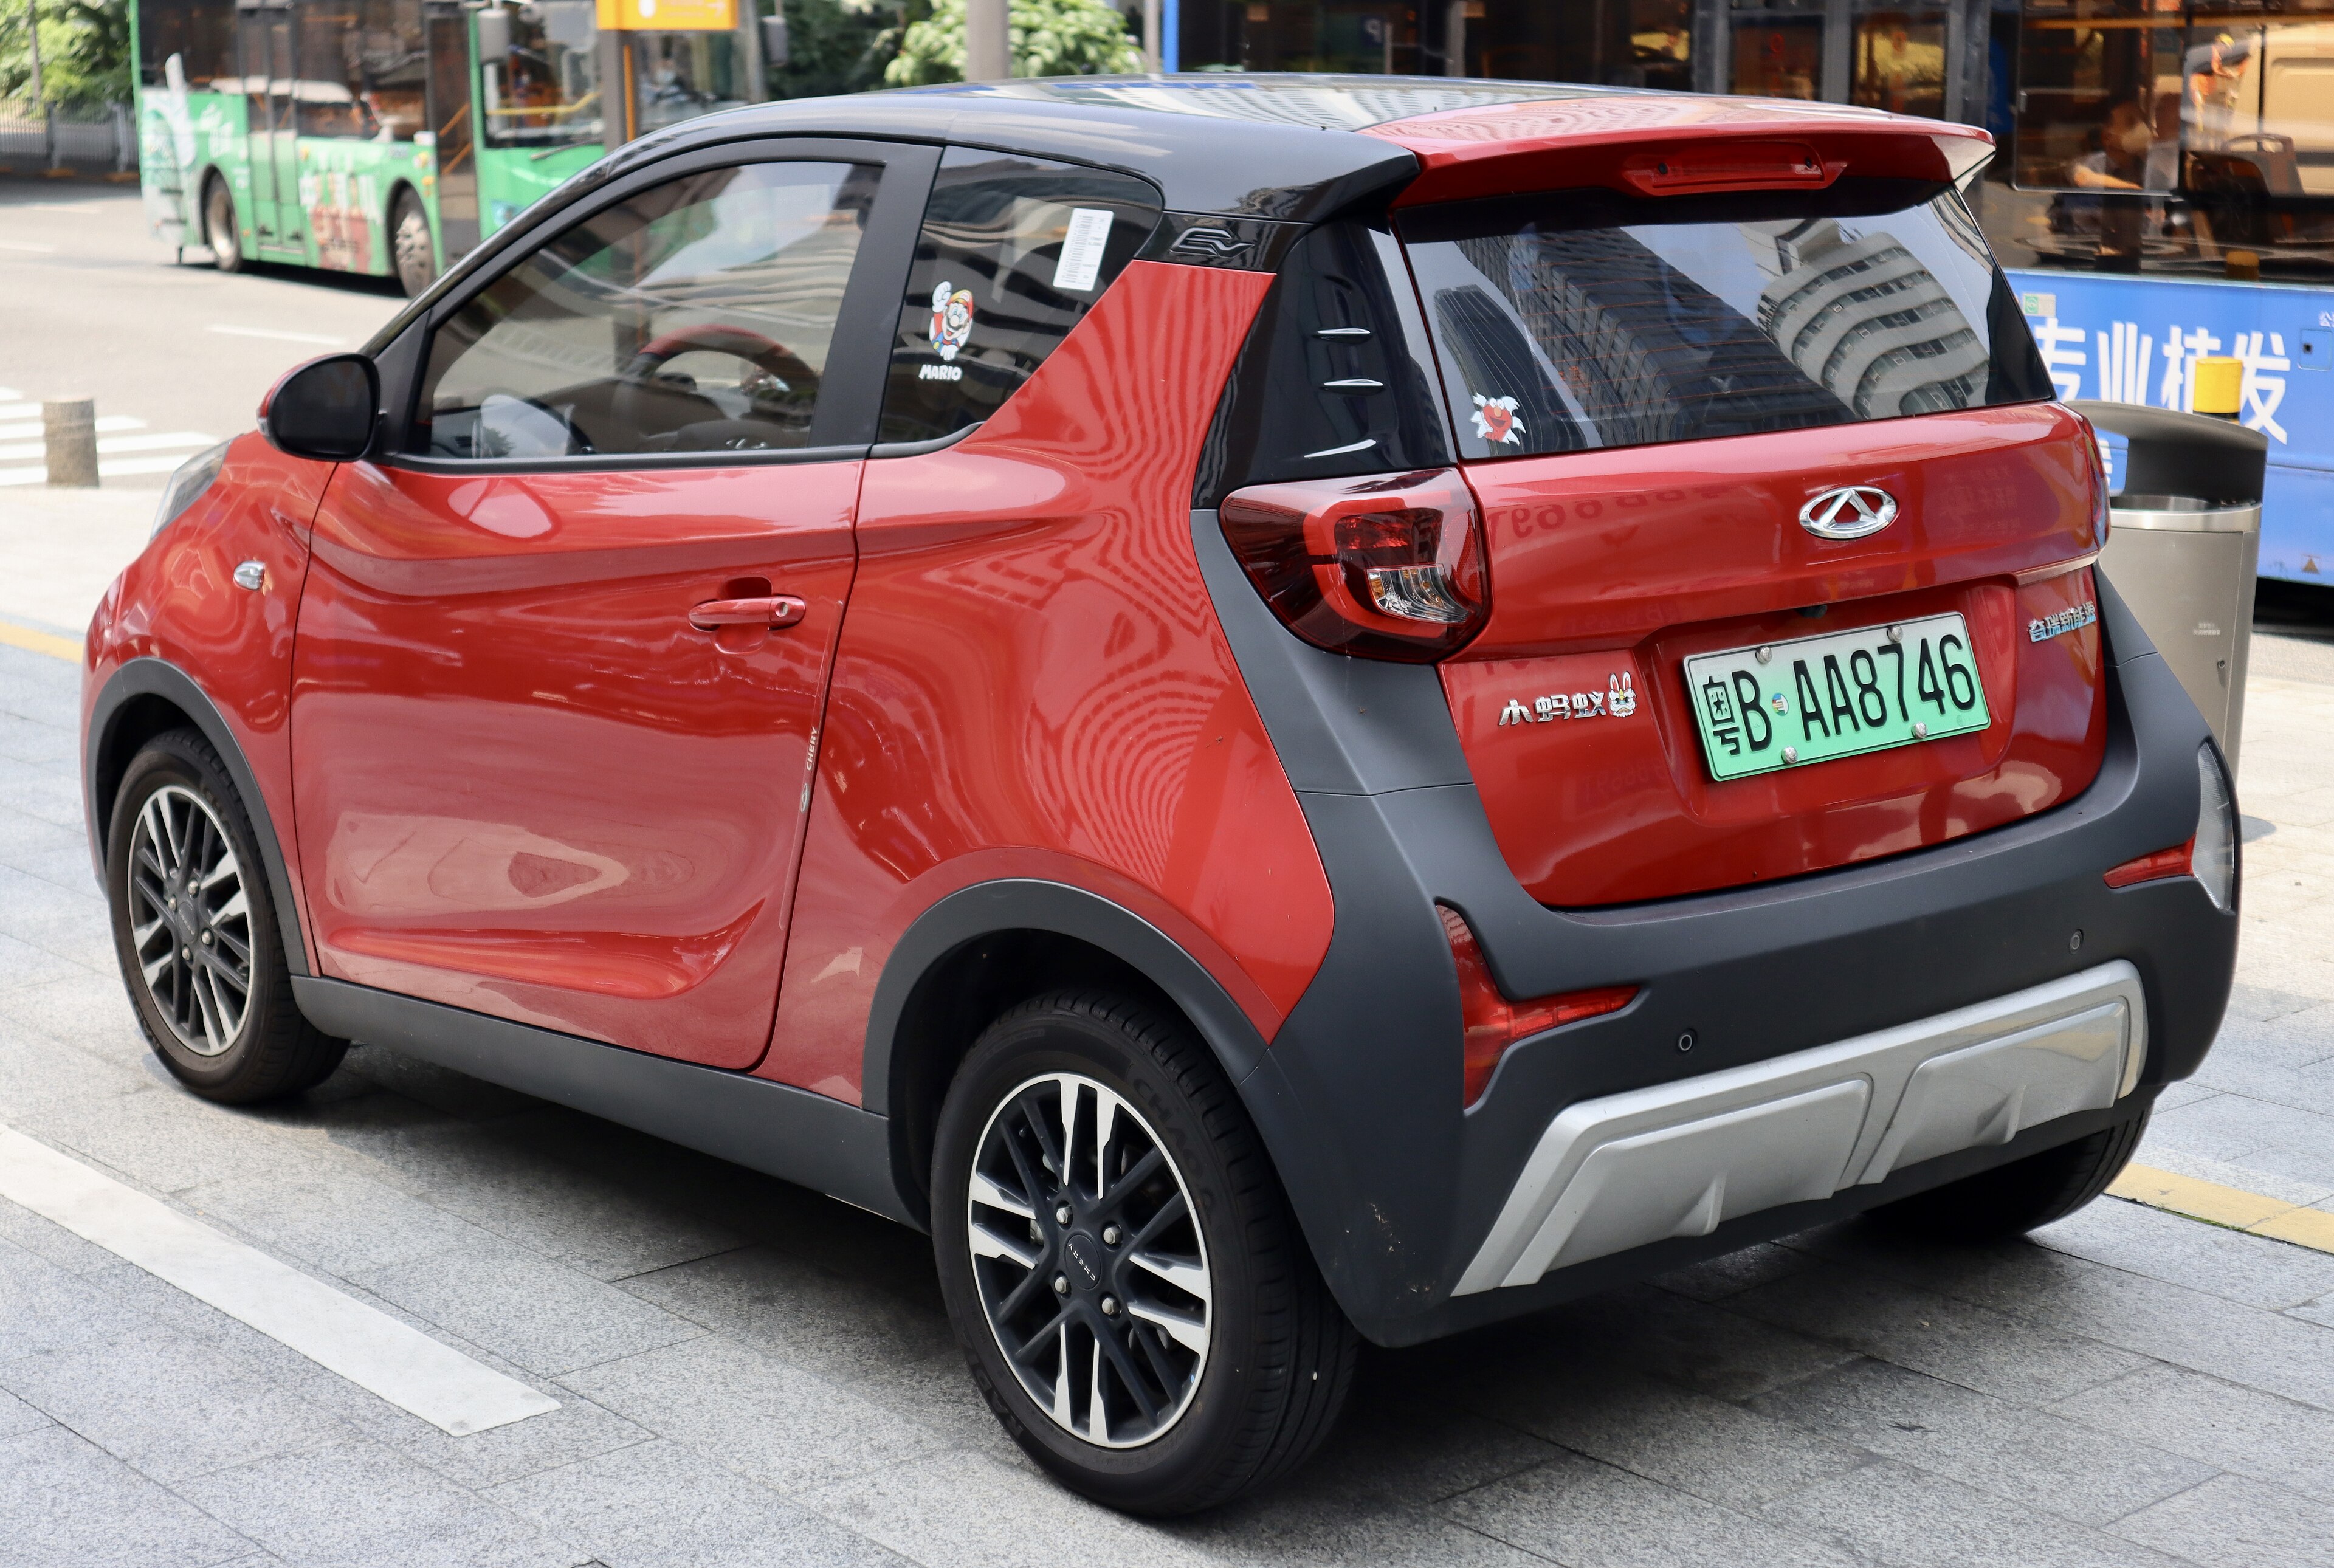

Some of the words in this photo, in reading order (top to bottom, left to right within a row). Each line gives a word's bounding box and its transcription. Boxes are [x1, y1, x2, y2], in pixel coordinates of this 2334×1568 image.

[918, 364, 963, 382] MARIO
[2028, 600, 2097, 643] 奇瑞新能源
[1498, 691, 1608, 726] 小蚂蚁
[807, 726, 819, 771] CHERY
[1069, 1244, 1096, 1281] CHERY
